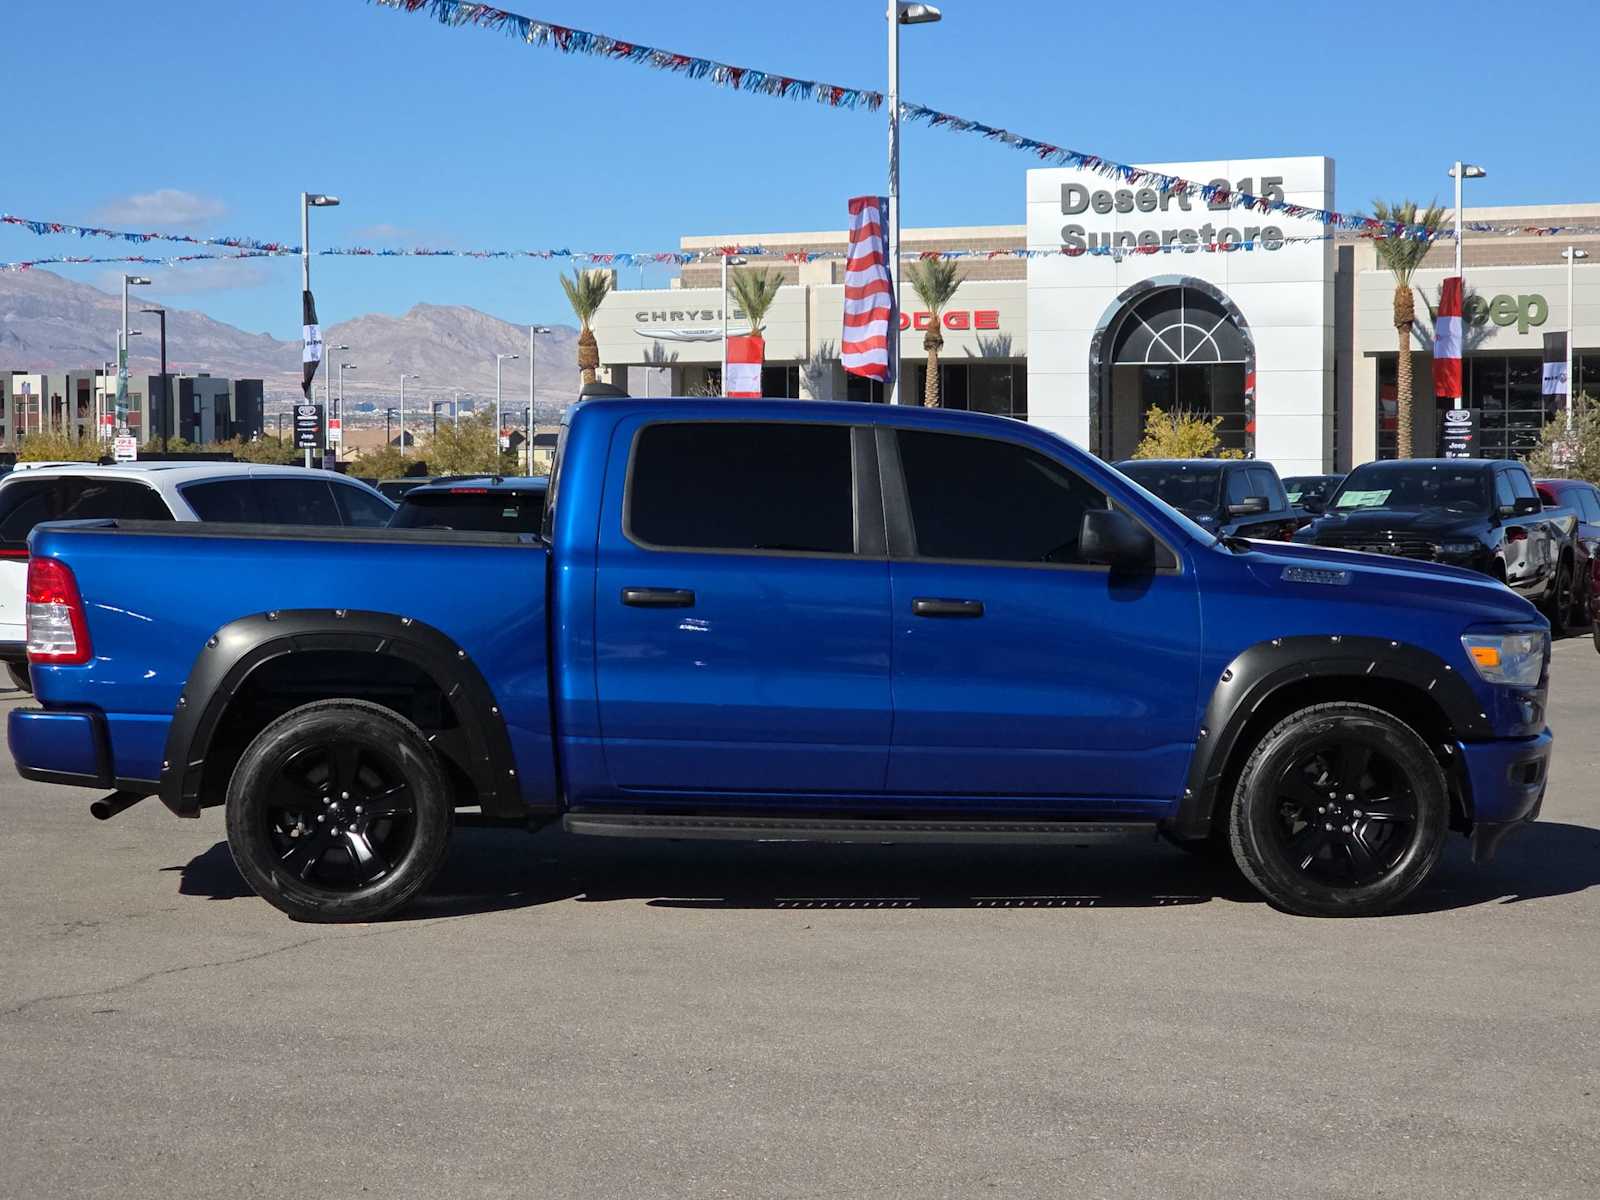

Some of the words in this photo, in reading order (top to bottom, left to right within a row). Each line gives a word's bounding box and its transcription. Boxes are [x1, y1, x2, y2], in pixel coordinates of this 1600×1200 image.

[1061, 183, 1192, 215] Desert
[1207, 176, 1285, 211] 215
[1061, 222, 1284, 263] Superstore
[635, 309, 748, 322] CHRYSLE
[899, 310, 1000, 331] DGE
[1431, 294, 1548, 334] eep
